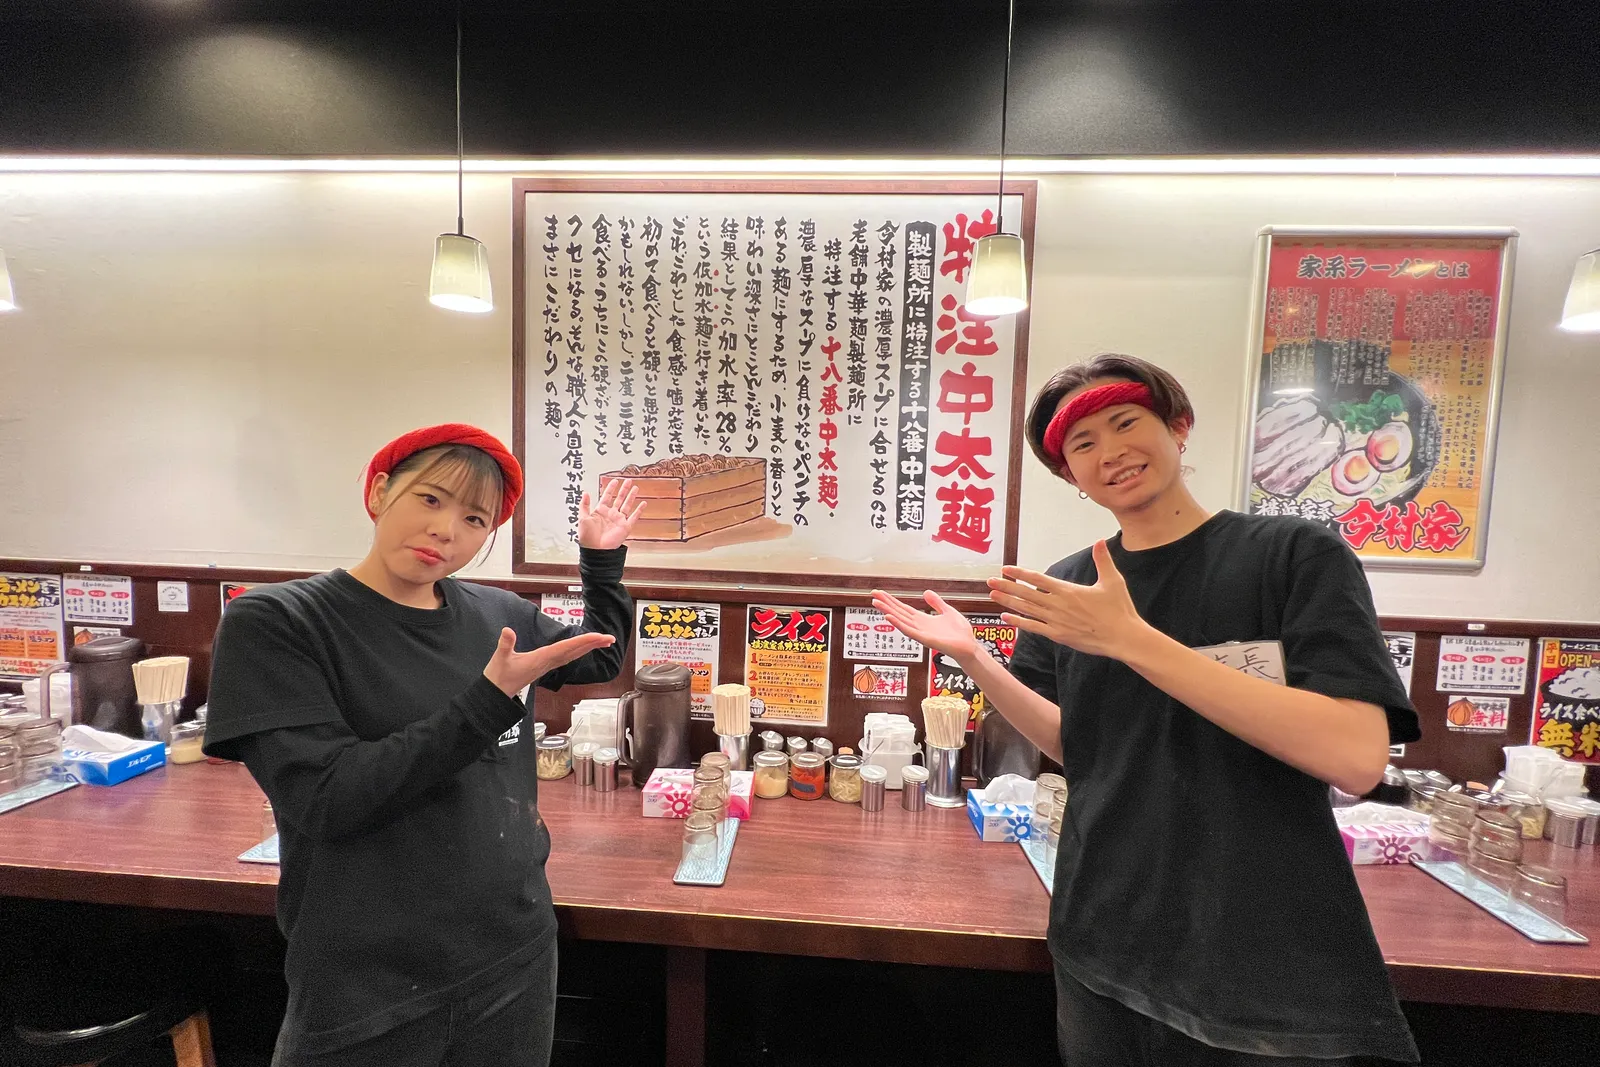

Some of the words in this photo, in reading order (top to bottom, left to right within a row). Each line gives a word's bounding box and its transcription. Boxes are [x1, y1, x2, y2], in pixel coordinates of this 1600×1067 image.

[543, 215, 562, 440] まさにこだわりの麺。
[591, 213, 612, 456] 食べるうちにこの硬さがきっと
[640, 216, 663, 457] 初めて食べると硬いと思われる
[744, 216, 765, 453] 味わい深さにとことんこだわり
[846, 219, 868, 426] 老舗中華麺製麺所に
[1297, 255, 1470, 279] 家系ラーメンとは
[792, 218, 817, 527] 濃厚なスープに負けないパンチの
[897, 230, 933, 527] 製麺所に特注する十八番中太麺
[643, 603, 708, 624] ラーメンを
[751, 608, 828, 643] ライス
[1333, 498, 1470, 552] 今村家
[875, 679, 907, 694] 無料
[1470, 710, 1506, 727] 無料
